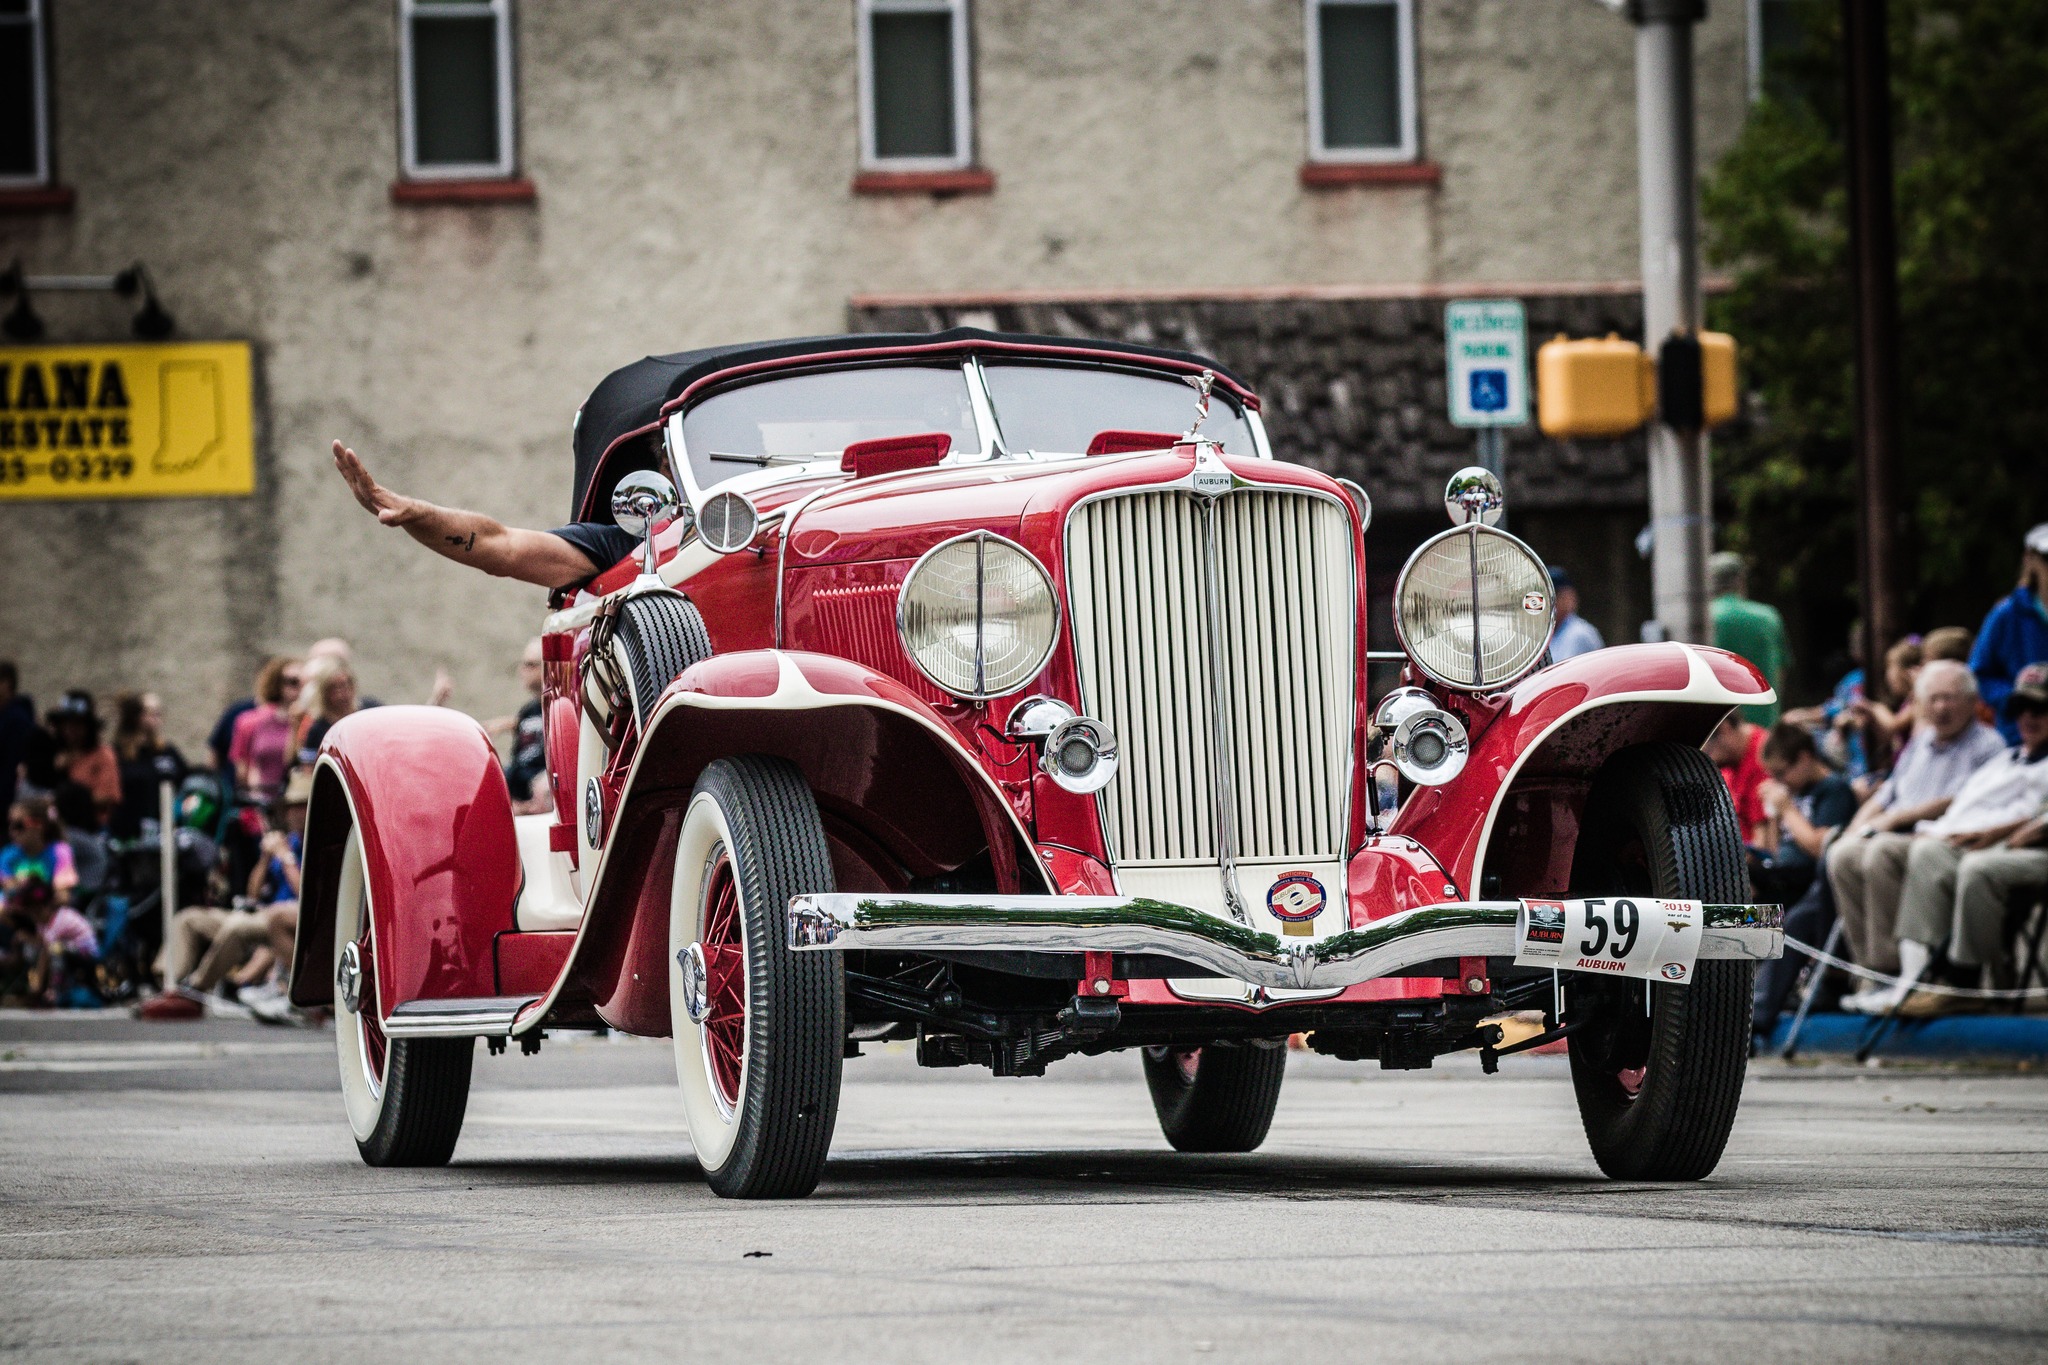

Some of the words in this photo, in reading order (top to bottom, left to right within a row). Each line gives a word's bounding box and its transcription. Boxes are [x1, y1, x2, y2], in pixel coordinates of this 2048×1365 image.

[1274, 885, 1297, 902] AUBURN
[1662, 902, 1692, 911] 2019
[1529, 930, 1563, 939] AUBURN
[1580, 899, 1639, 959] 59
[1576, 958, 1627, 972] AUBURN
